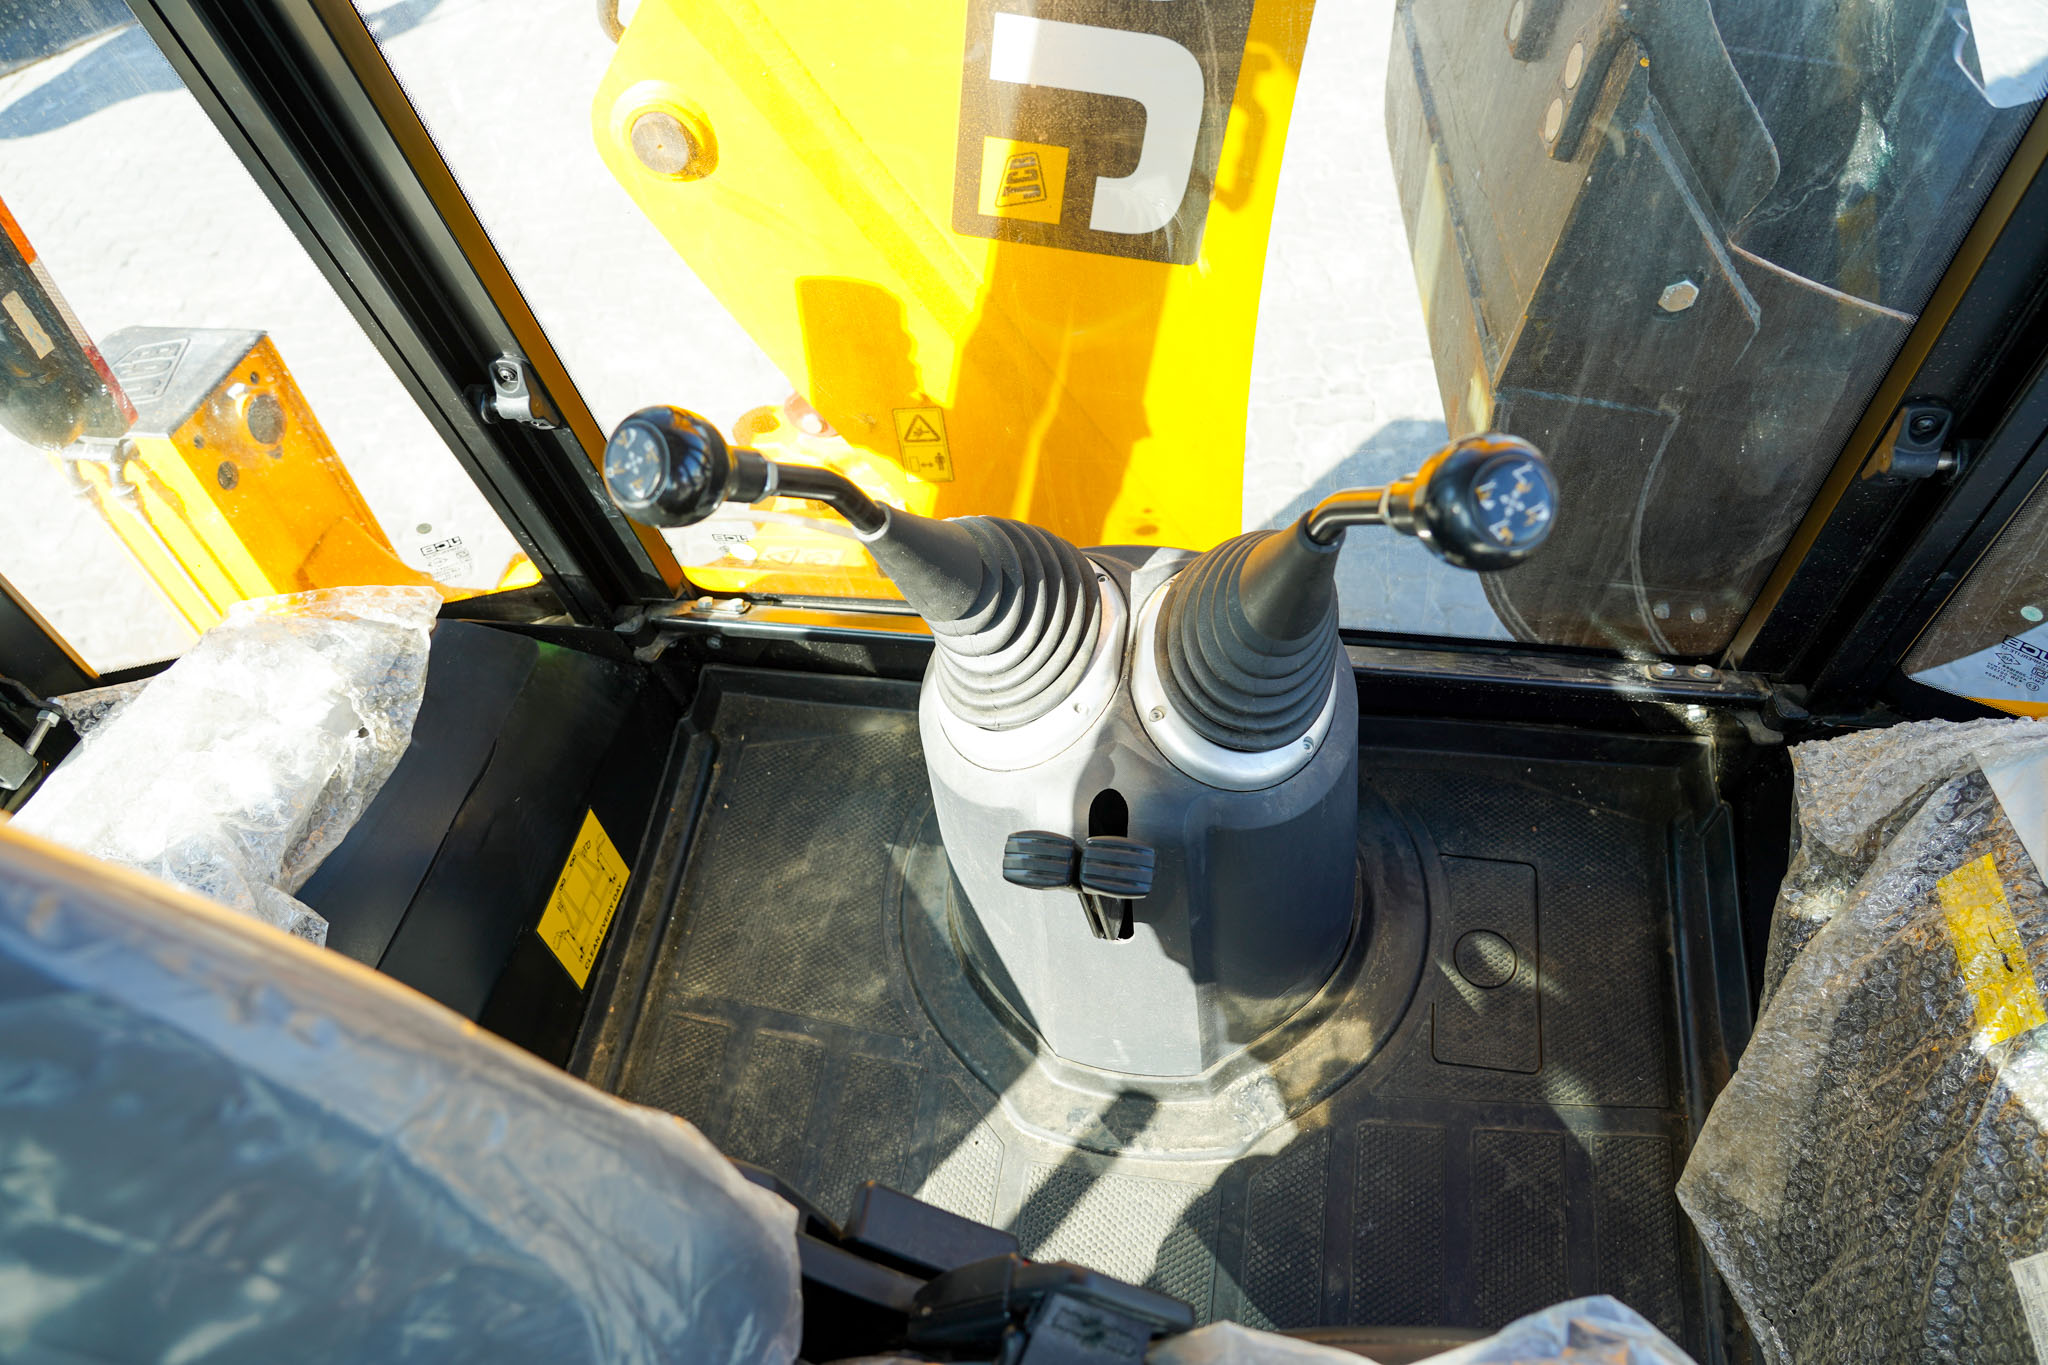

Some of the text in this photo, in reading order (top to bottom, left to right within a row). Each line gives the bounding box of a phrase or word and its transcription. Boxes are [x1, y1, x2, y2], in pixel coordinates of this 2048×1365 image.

[1001, 156, 1042, 199] JCB
[585, 881, 623, 970] CLEAN EVERY DAY
